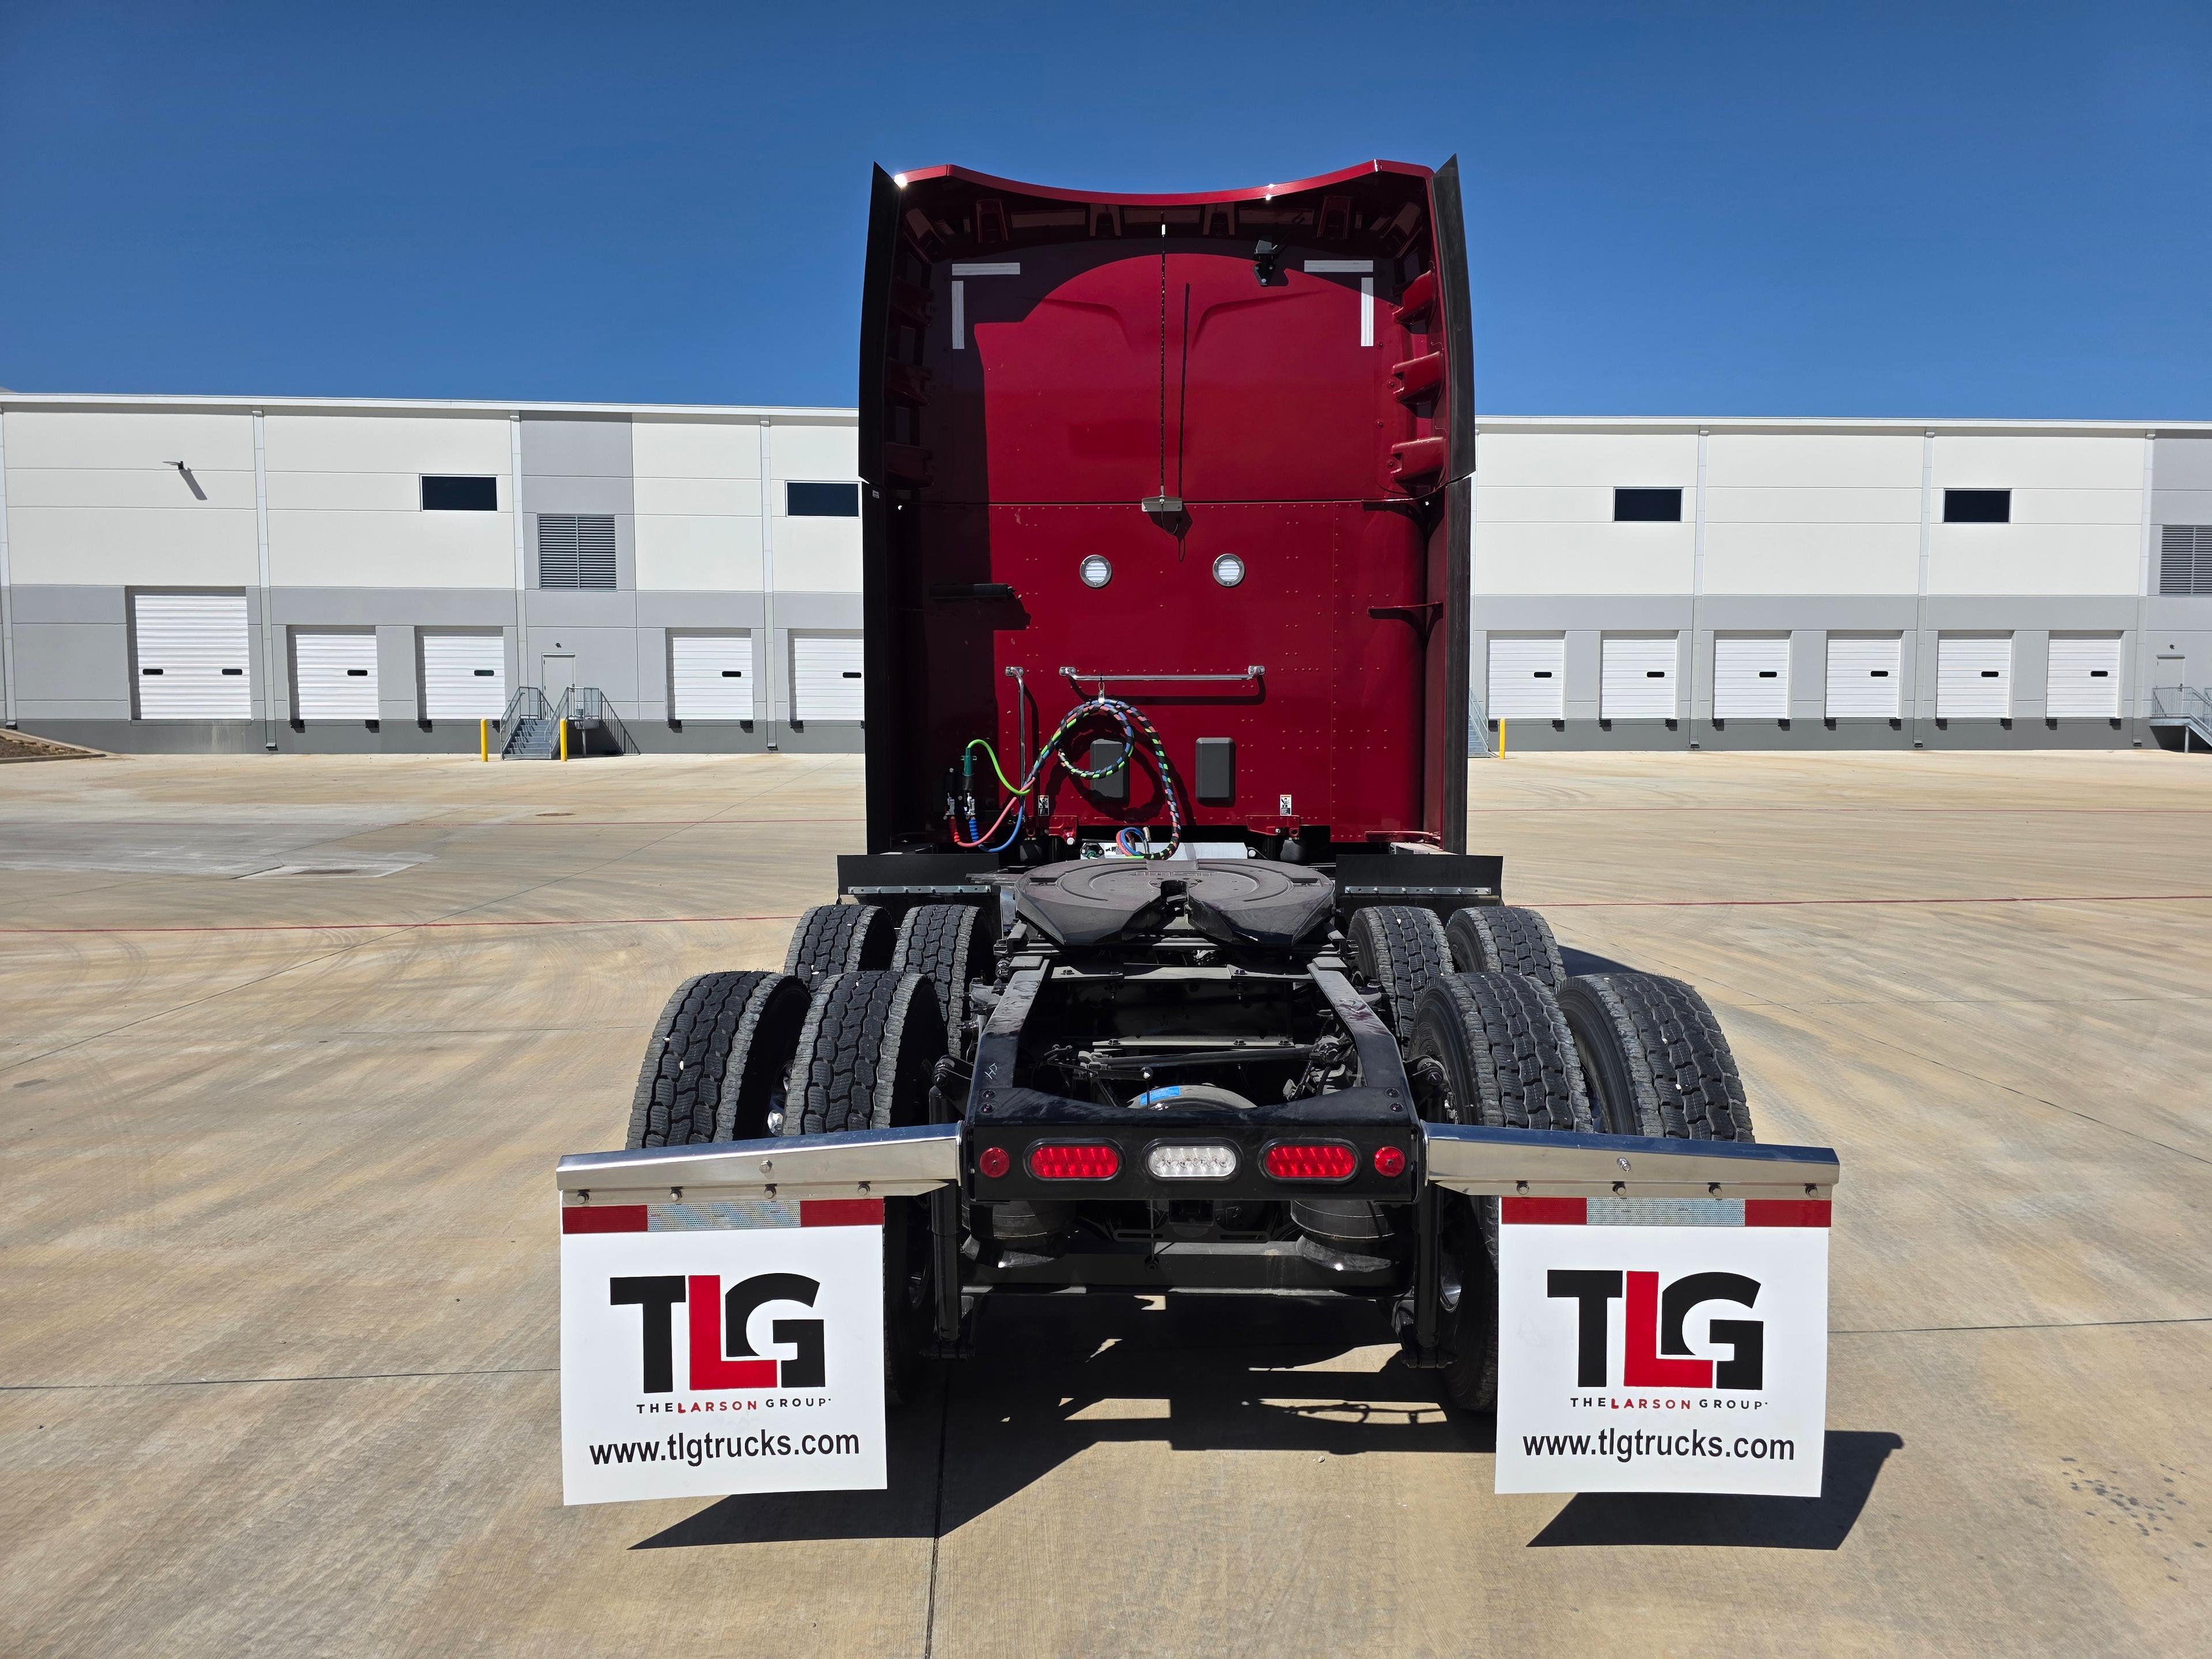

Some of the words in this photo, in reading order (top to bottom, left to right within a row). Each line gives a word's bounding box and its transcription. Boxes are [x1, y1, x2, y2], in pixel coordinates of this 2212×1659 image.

[610, 1273, 826, 1393] TLG
[1547, 1270, 1764, 1390] TLG
[766, 1398, 826, 1408] GROUP
[1699, 1399, 1762, 1410] GROUP
[589, 1429, 859, 1467] www.tlgtrucks.com
[1523, 1428, 1794, 1463] www.tlgtrucks.com
